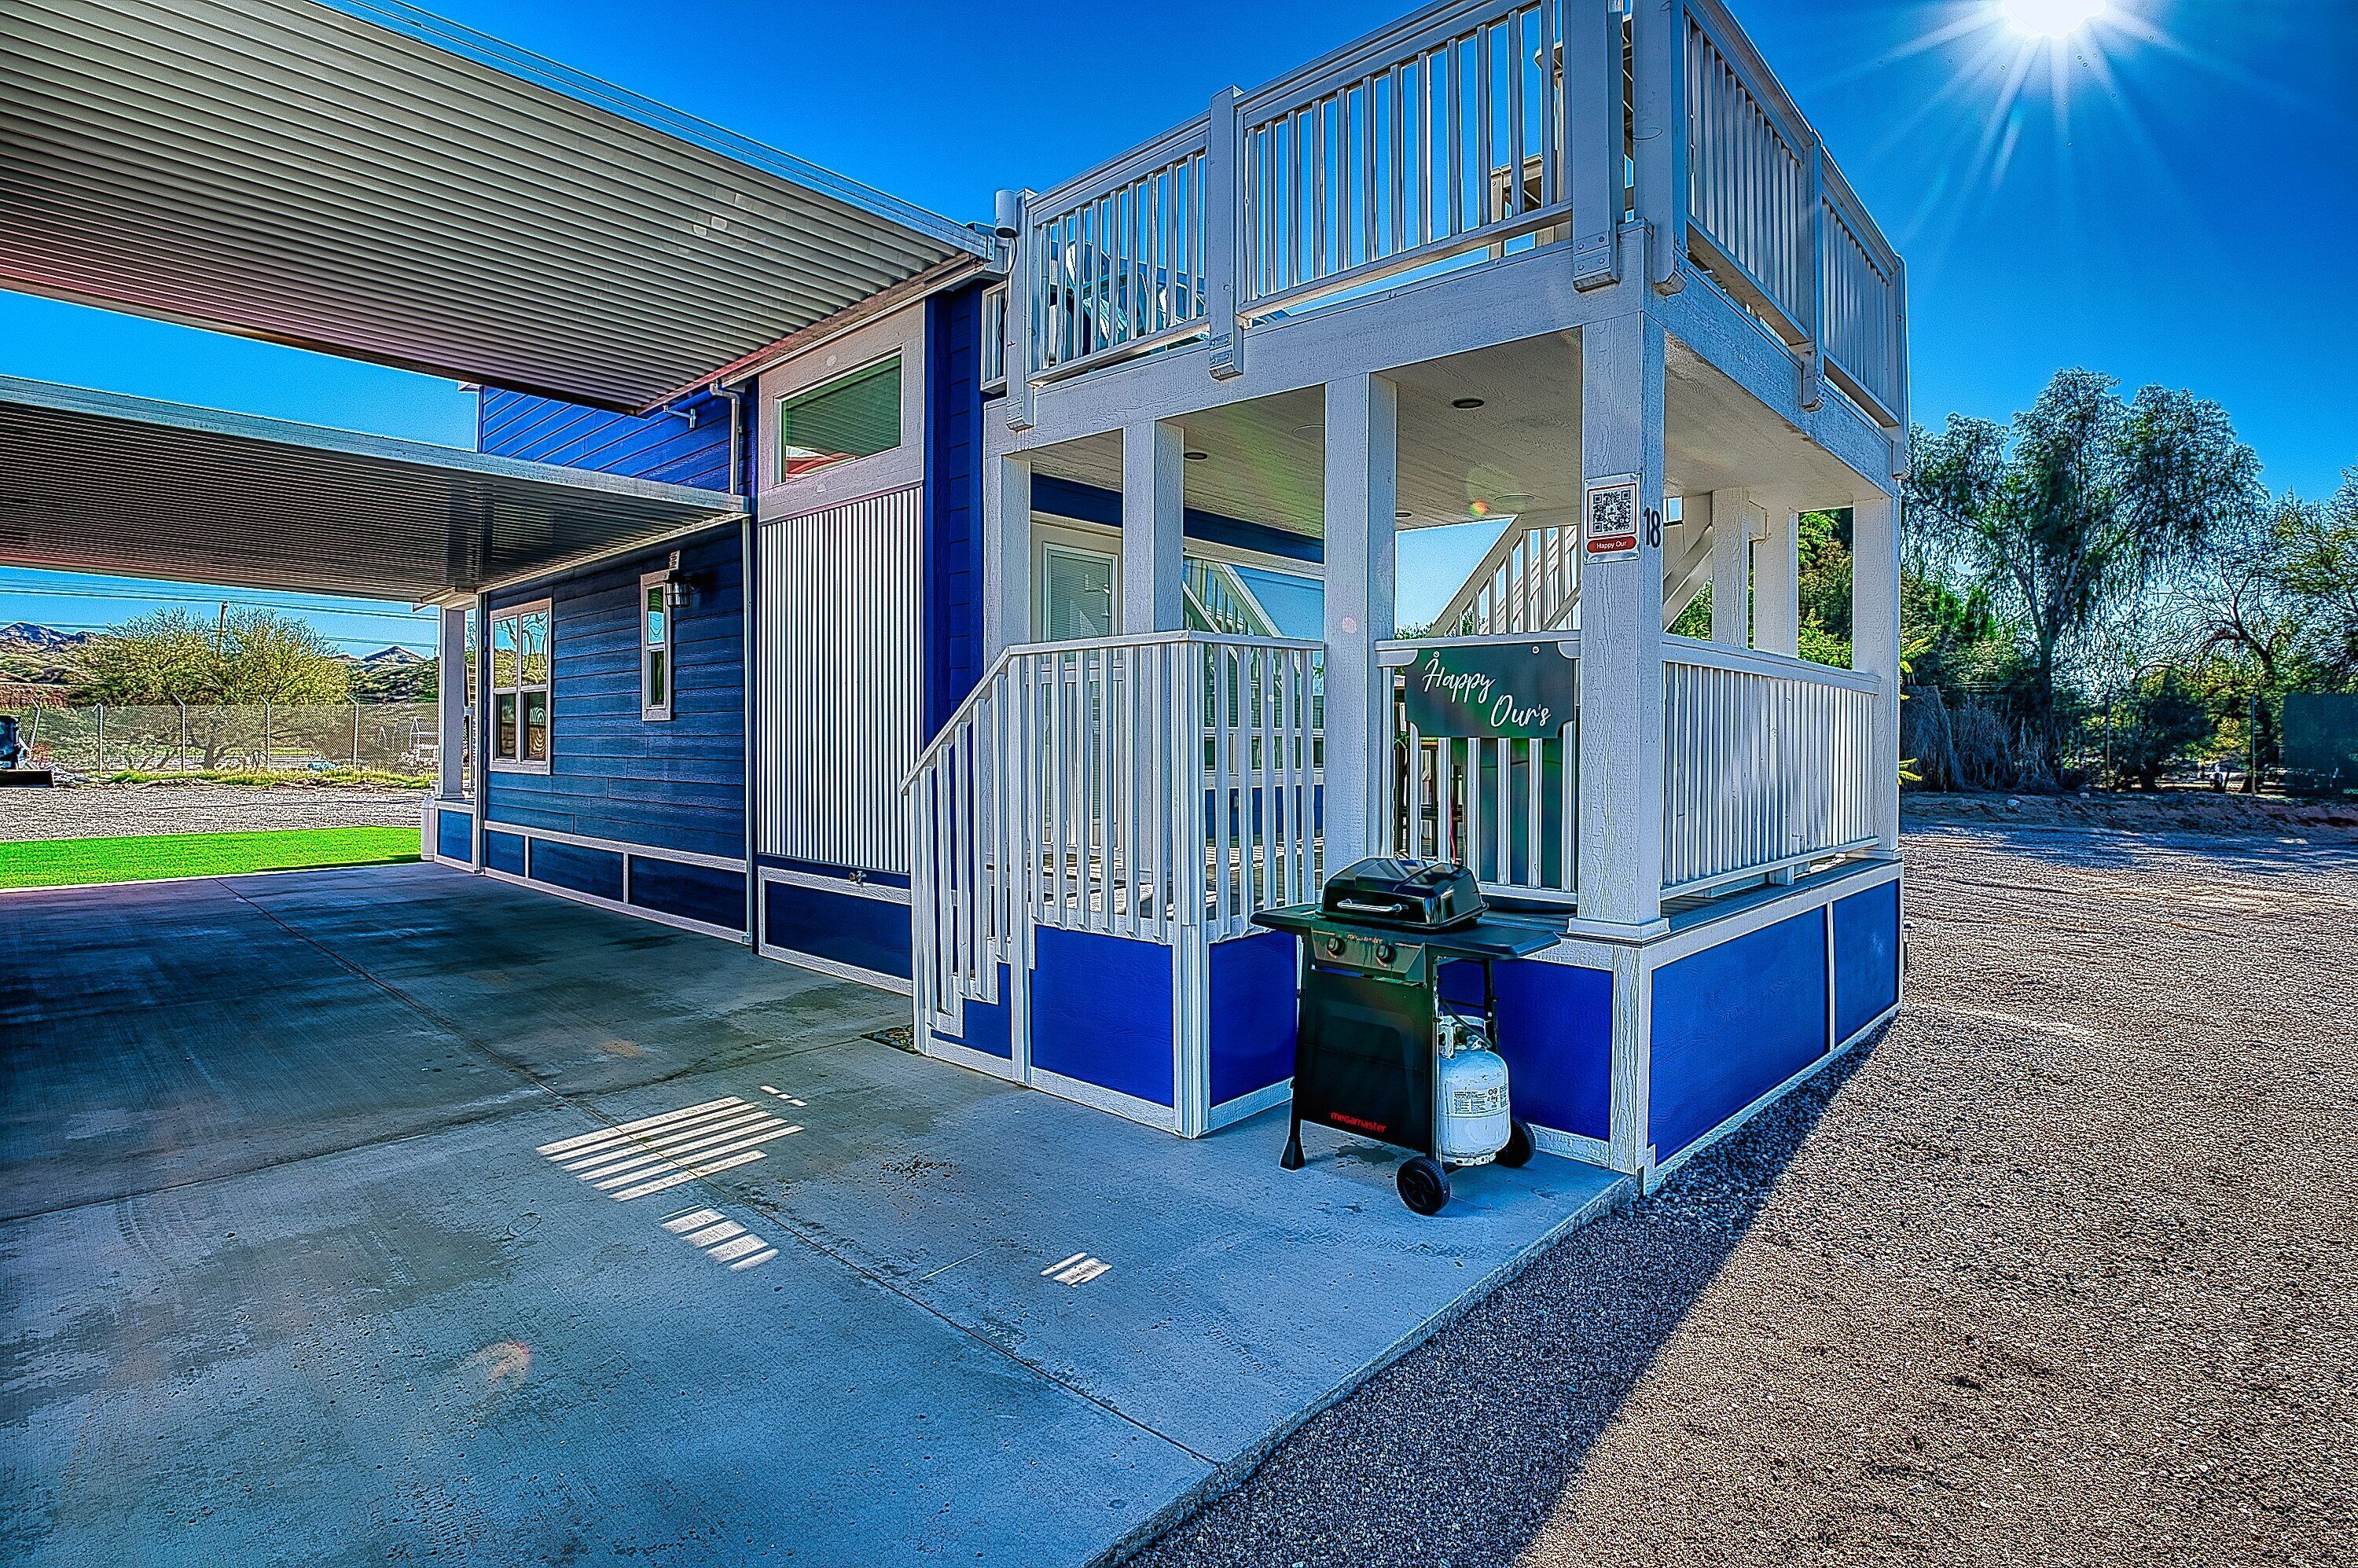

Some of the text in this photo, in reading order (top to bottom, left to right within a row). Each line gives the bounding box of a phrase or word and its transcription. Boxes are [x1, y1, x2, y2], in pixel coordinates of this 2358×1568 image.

[1644, 507, 1661, 549] 18
[1422, 658, 1496, 703] Happy
[1490, 695, 1551, 727] Our's
